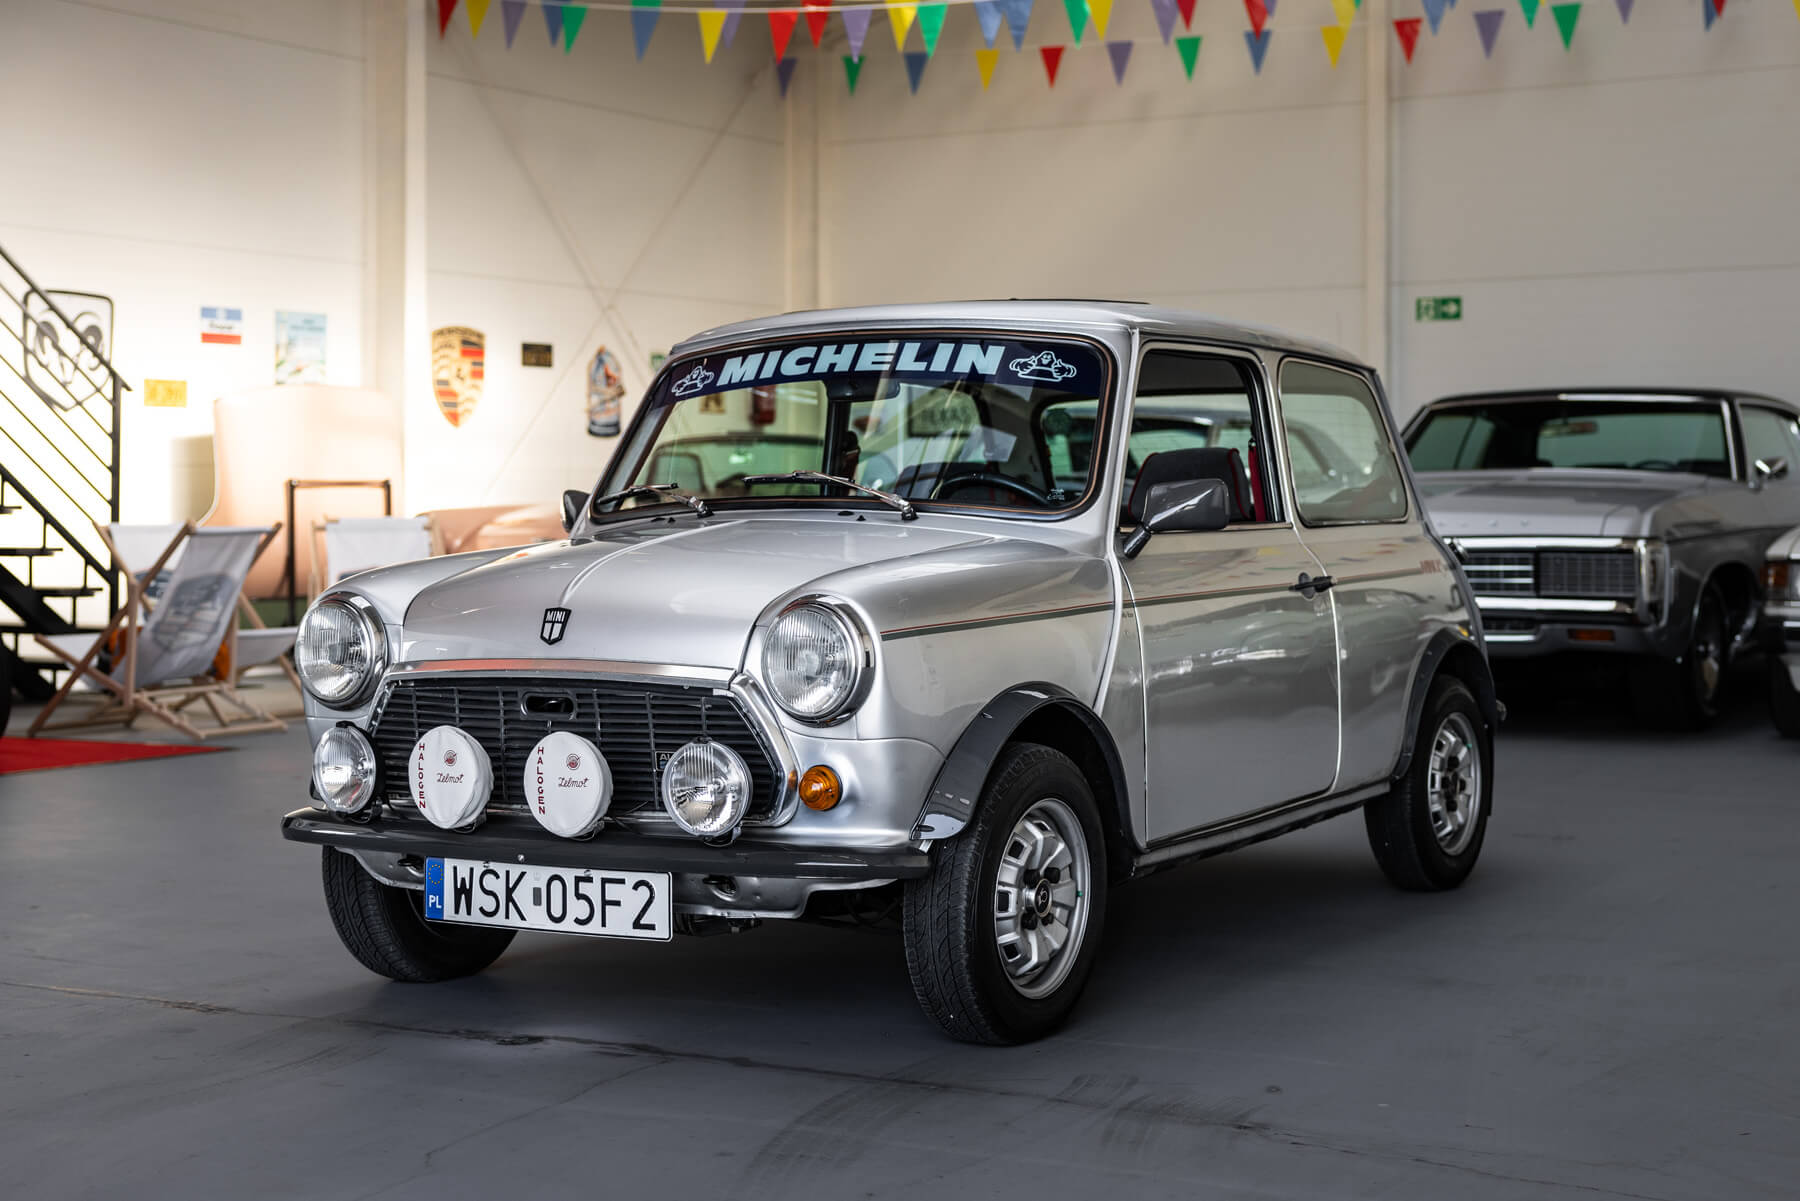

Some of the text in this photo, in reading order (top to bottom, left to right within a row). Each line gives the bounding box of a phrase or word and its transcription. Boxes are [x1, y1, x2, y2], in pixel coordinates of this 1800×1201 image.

[716, 343, 1005, 386] MICHELIN
[546, 610, 566, 622] MINI
[418, 743, 426, 809] HALOGEN
[436, 772, 464, 784] Zelmot
[537, 746, 545, 815] HALOGEN
[558, 776, 590, 788] Zelmot
[428, 894, 443, 909] PL
[453, 865, 657, 932] WSK 05F2
